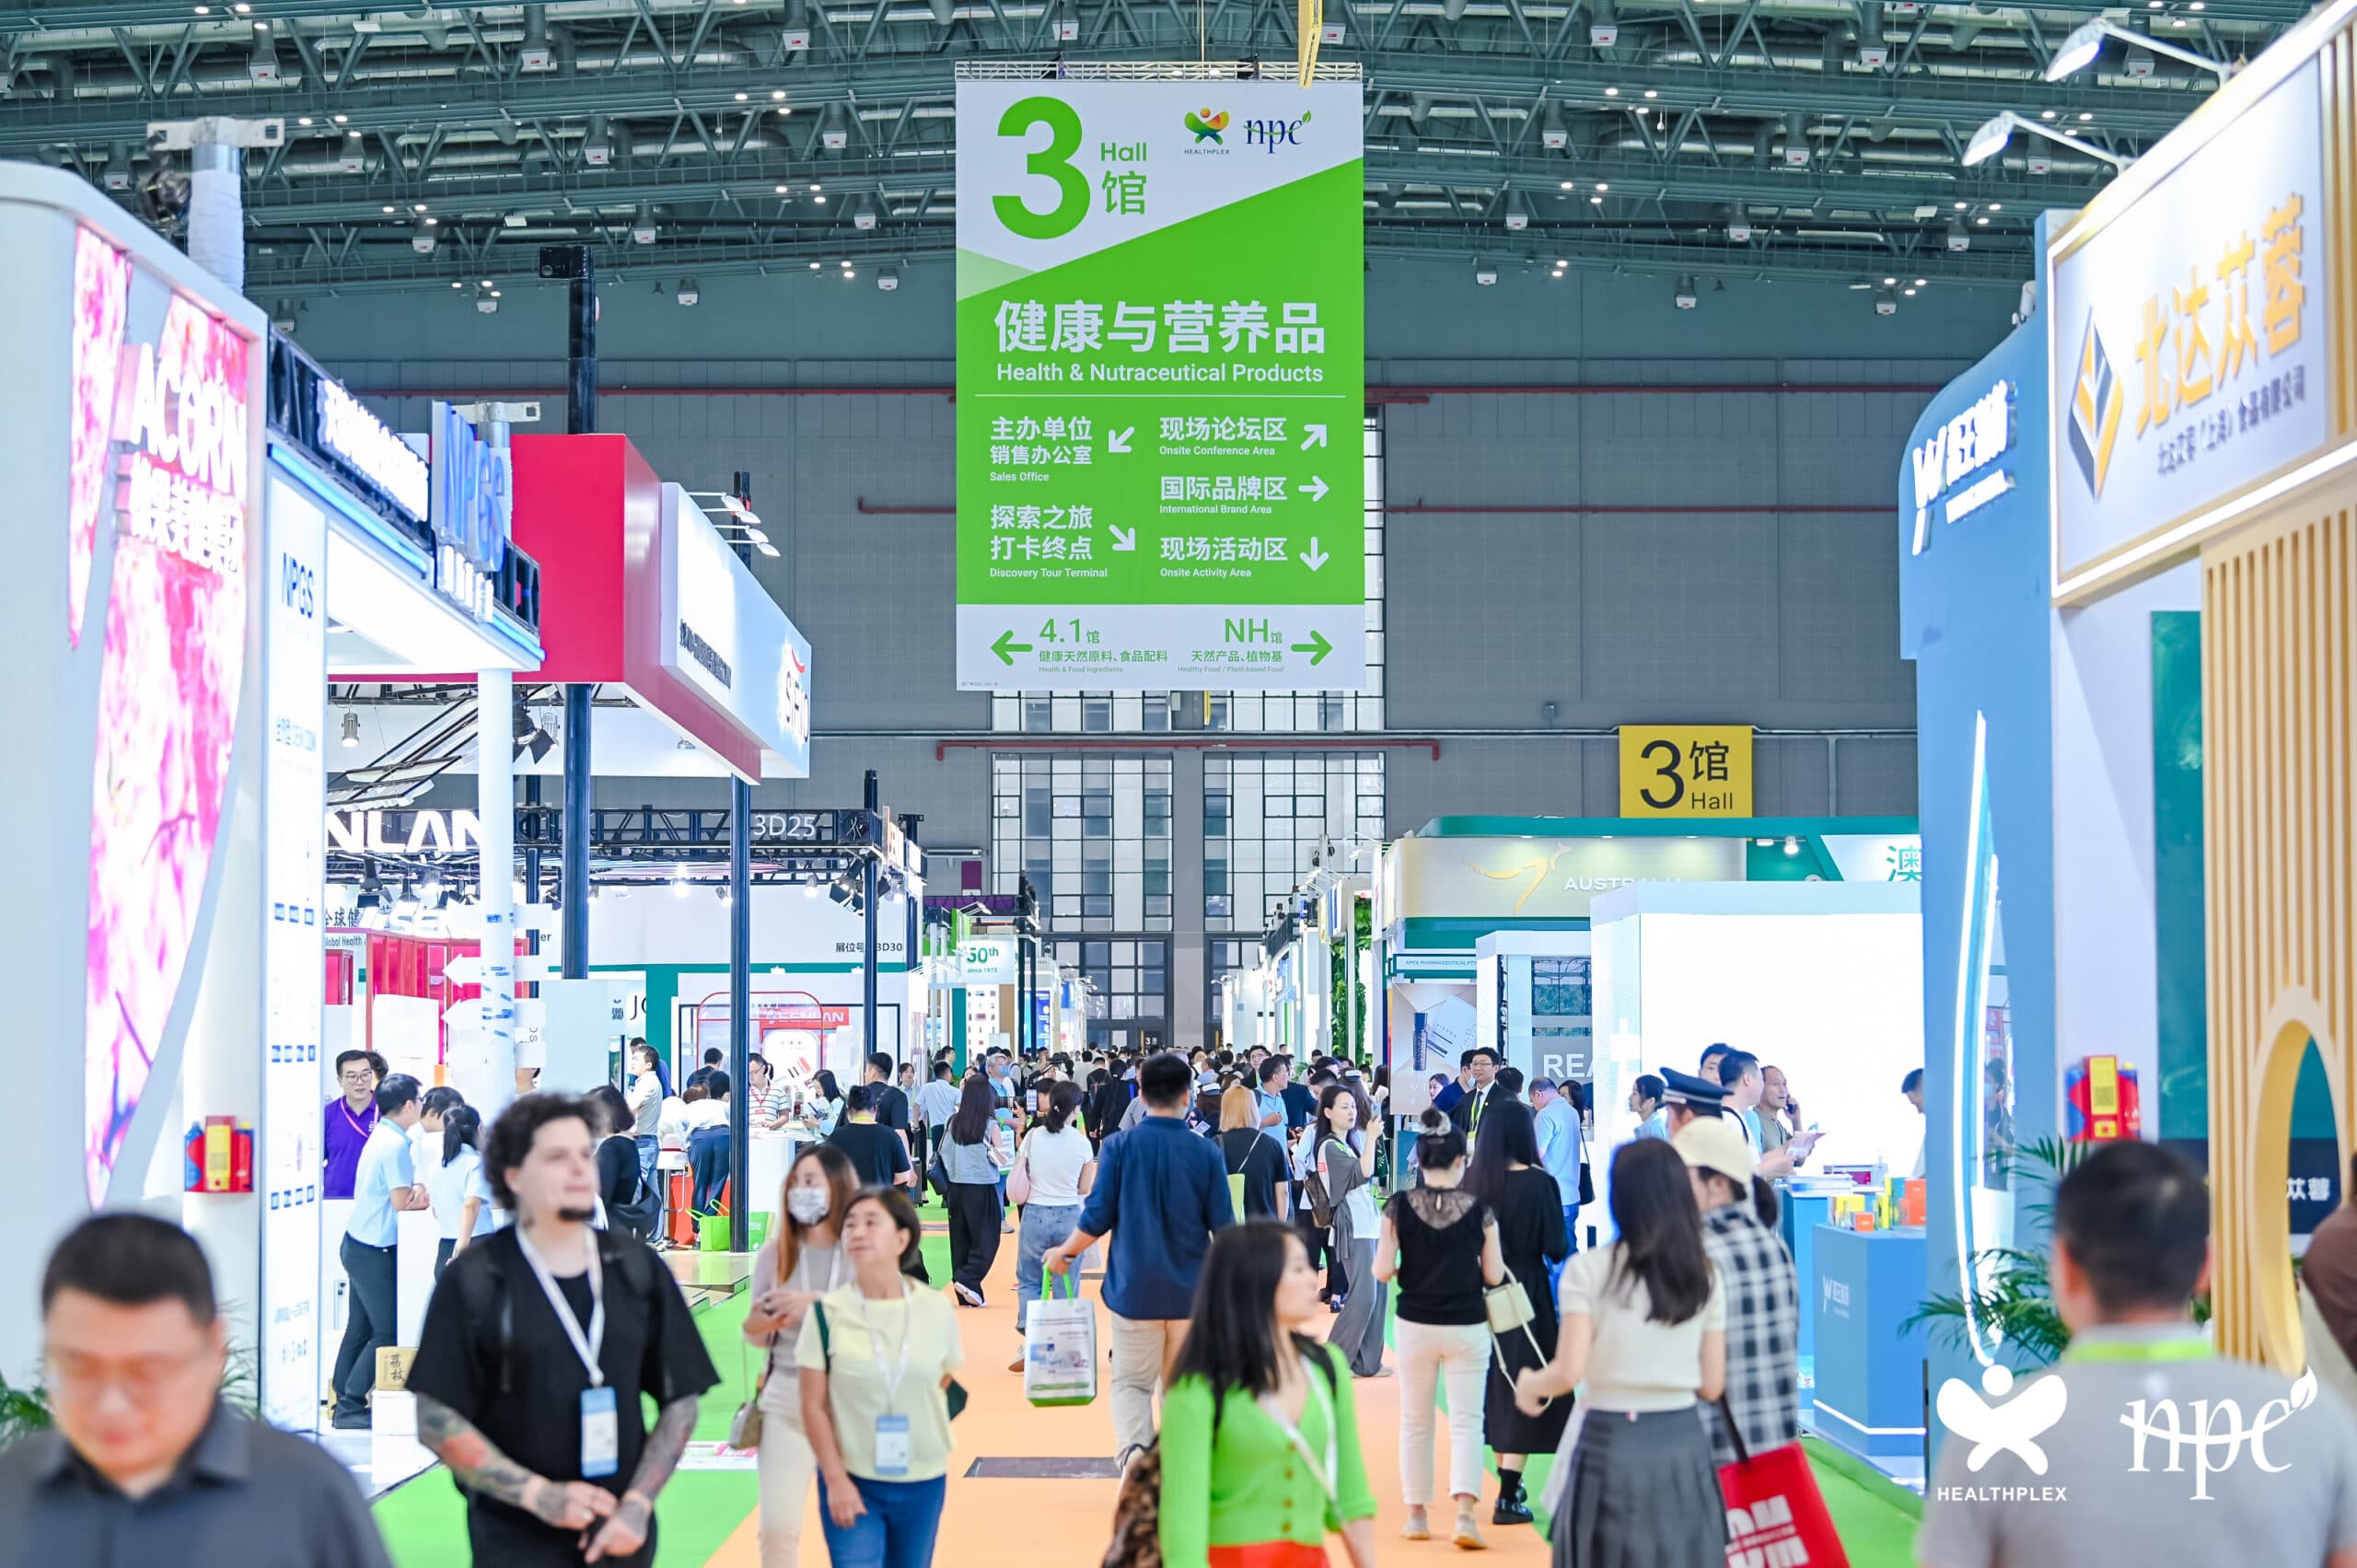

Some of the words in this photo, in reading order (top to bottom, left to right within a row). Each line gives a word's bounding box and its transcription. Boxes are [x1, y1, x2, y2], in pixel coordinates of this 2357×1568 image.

[1244, 118, 1305, 154] npc
[1101, 143, 1147, 161] Hall
[993, 97, 1091, 239] 3
[1102, 170, 1147, 215] 馆
[994, 300, 1325, 354] 健康与营养品
[997, 363, 1063, 382] Health
[1069, 364, 1084, 382] &
[1090, 363, 1226, 382] Nutraceutical
[1233, 363, 1324, 383] Products
[129, 342, 247, 501] ACORN
[990, 416, 1093, 441] 主办单位
[1159, 417, 1288, 441] 现场论坛区
[990, 446, 1093, 465] 销售办公室
[1159, 446, 1191, 456] Onsite
[1194, 446, 1250, 456] Conference
[1253, 446, 1275, 456] Area
[990, 472, 1016, 482] Sales
[1019, 471, 1050, 482] Office
[1160, 476, 1288, 501] 国际品牌区
[990, 505, 1093, 530] 探索之旅
[1159, 505, 1218, 514] International
[1221, 505, 1248, 514] Brand
[1250, 505, 1272, 514] Area
[990, 535, 1093, 561] 打卡终点
[1160, 537, 1288, 561] 现场活动区
[990, 567, 1039, 580] Discovery
[1041, 567, 1062, 578] Tour
[1065, 567, 1108, 578] Terminal
[1160, 568, 1190, 578] Onsite
[1193, 567, 1227, 580] Activity
[1230, 568, 1252, 578] Area
[1039, 650, 1168, 663] 健康天然原料、食品配料
[1191, 650, 1283, 663] 天然产品、植物基
[1178, 666, 1202, 674] Healthy
[1689, 740, 1729, 781] 馆
[1640, 739, 1684, 809] 3
[1691, 792, 1733, 810] Hall
[753, 814, 818, 837] 3D25
